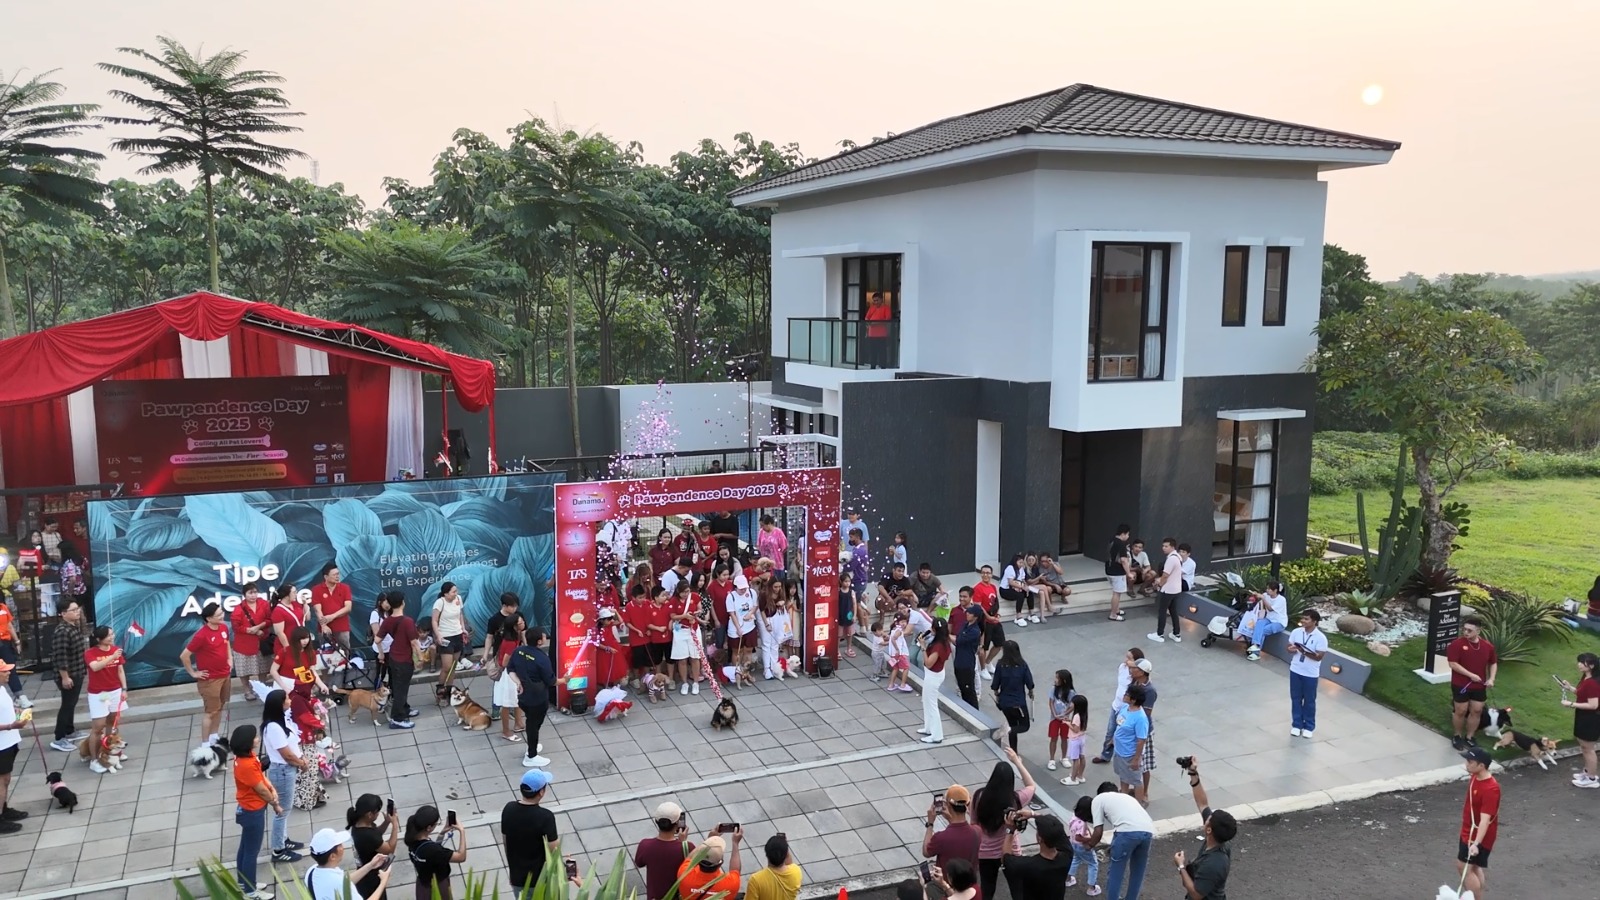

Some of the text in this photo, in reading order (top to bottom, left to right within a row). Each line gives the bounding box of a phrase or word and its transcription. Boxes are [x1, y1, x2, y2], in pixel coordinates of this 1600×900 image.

[141, 398, 310, 418] Pawpendence Day
[206, 417, 251, 433] 2025
[633, 484, 775, 505] Pawpendence Day 2025
[380, 548, 480, 565] Elevating Senses
[212, 561, 280, 586] Tipe
[380, 568, 393, 577] to
[396, 564, 429, 576] Bring
[432, 563, 453, 573] the
[567, 568, 588, 580] TFS
[381, 572, 472, 589] Life Experience
